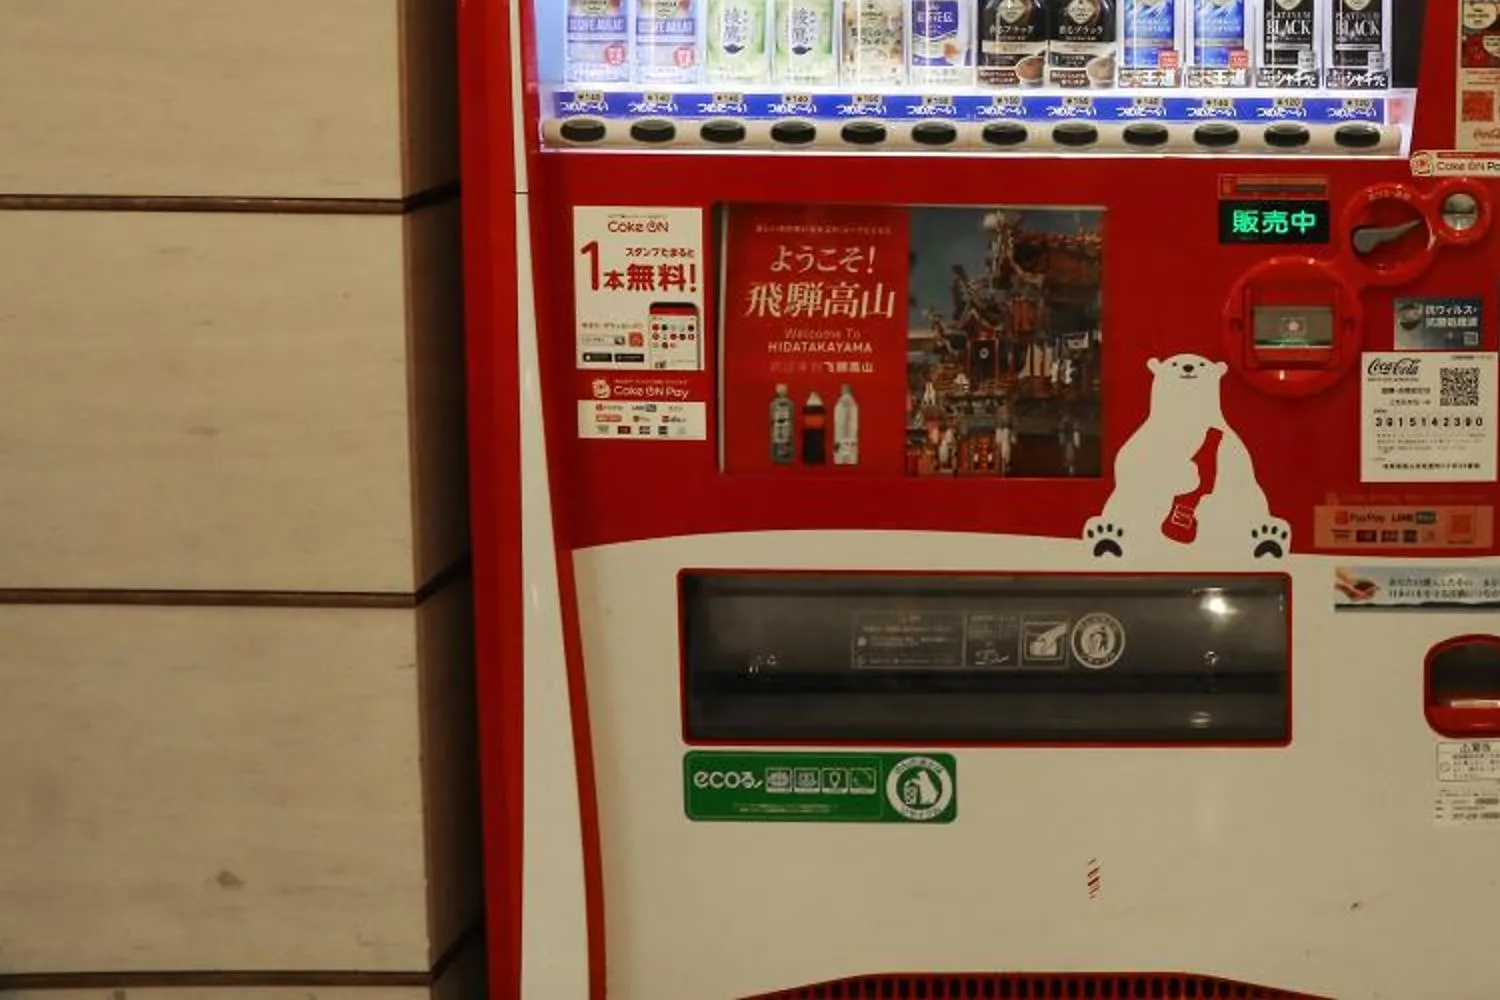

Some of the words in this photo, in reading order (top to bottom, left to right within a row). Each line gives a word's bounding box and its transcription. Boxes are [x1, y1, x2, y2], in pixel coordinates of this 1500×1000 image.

[1266, 19, 1312, 35] BLACK
[608, 220, 644, 233] Coke
[1232, 210, 1316, 233] 販売中
[769, 245, 876, 274] ようこそ!
[768, 341, 874, 354] HIDATAKAYAMA
